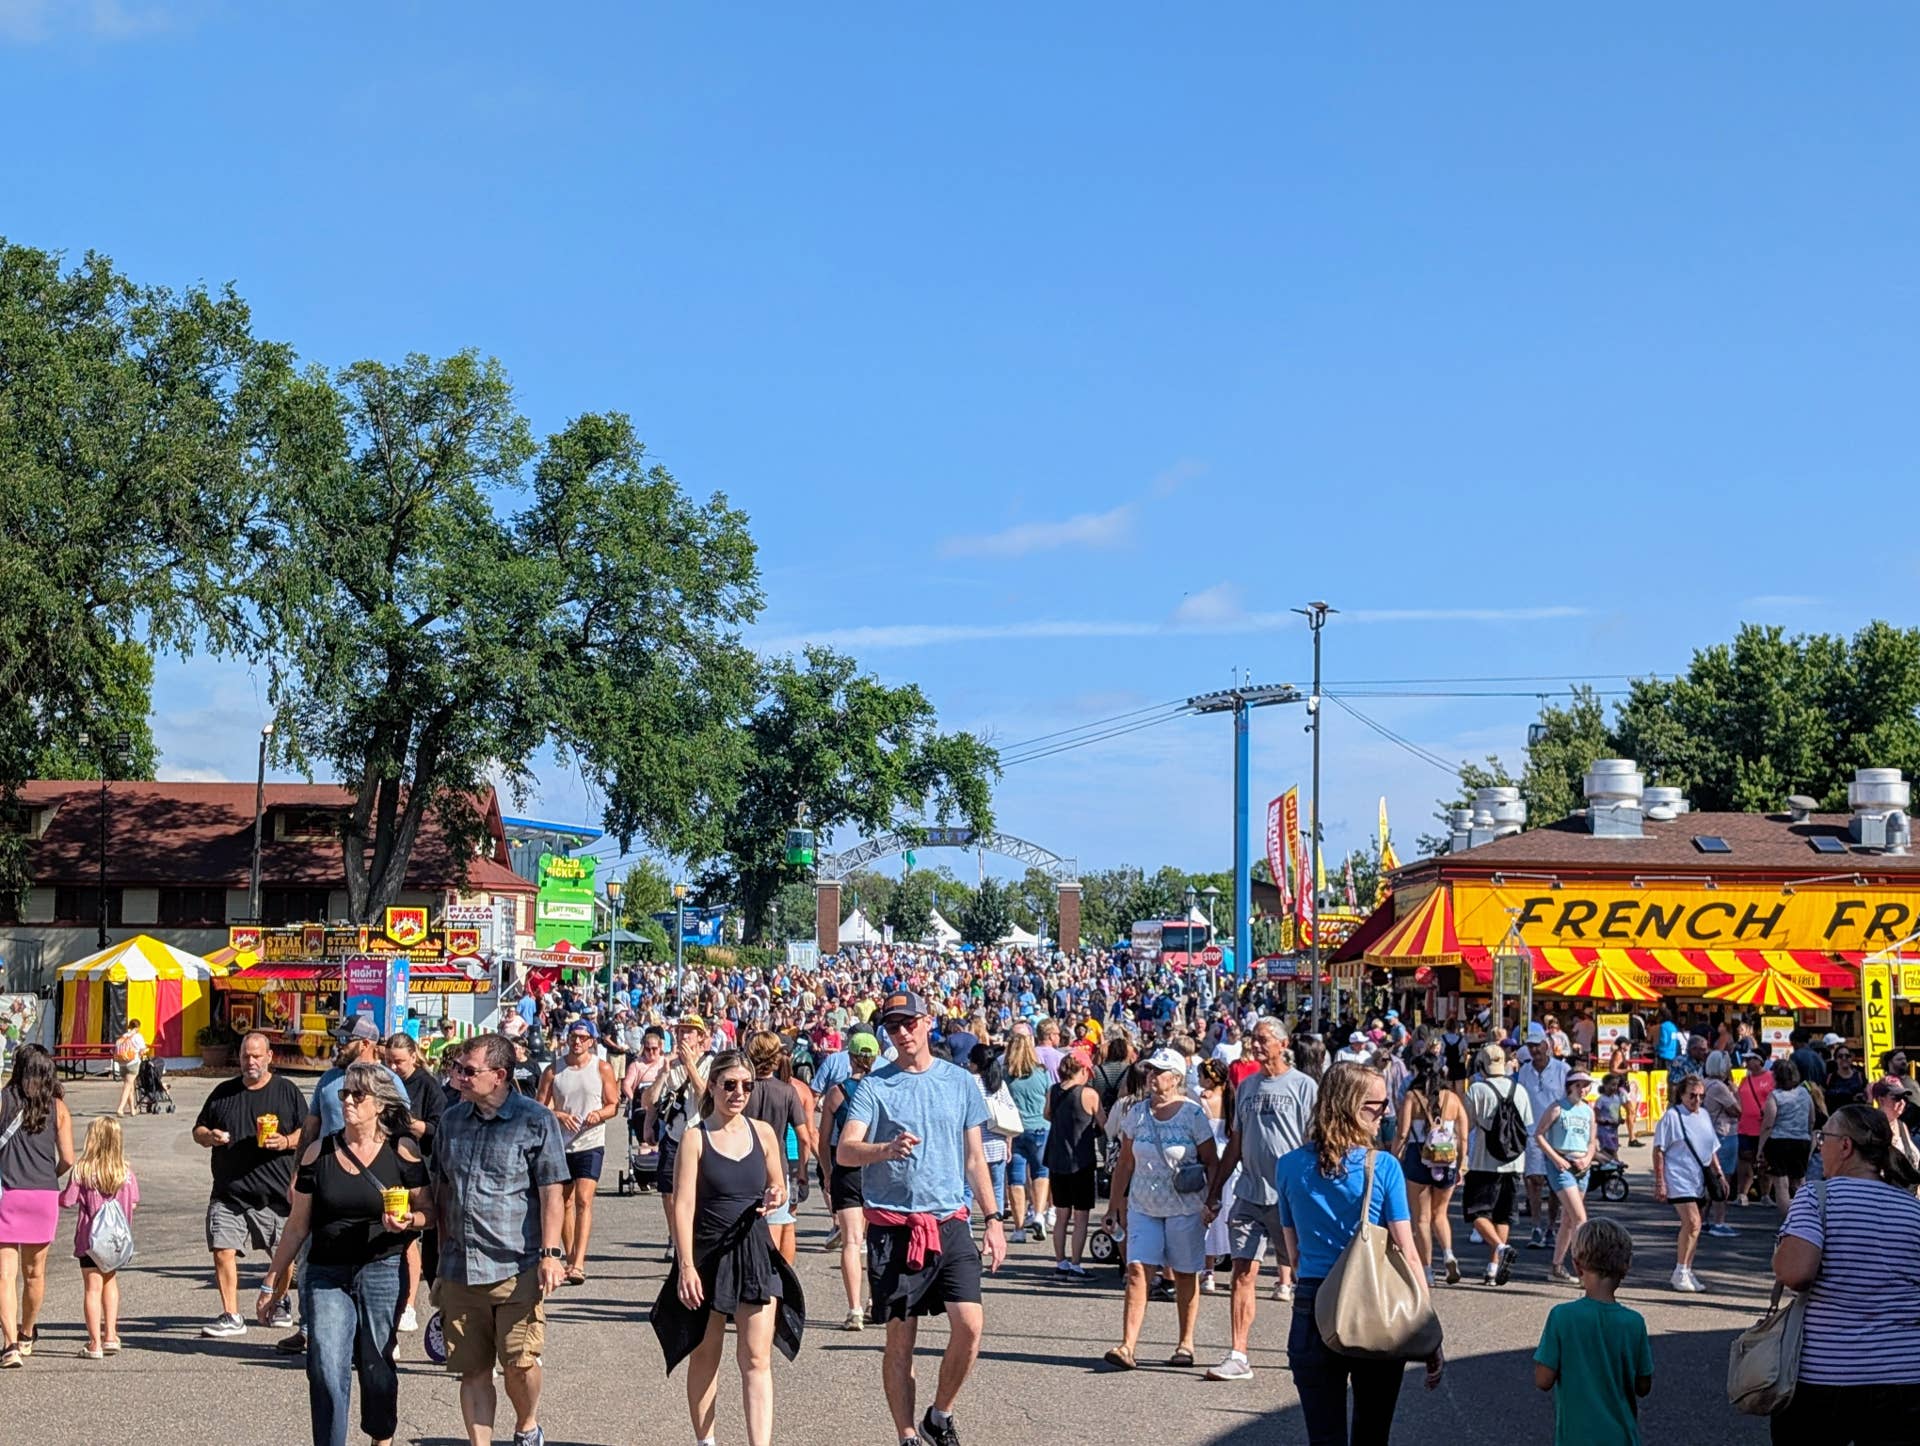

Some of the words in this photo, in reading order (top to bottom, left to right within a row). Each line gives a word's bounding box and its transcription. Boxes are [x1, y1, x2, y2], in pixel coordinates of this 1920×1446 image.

[1515, 897, 1786, 940] FRENCH
[266, 936, 302, 947] STEAK
[1203, 953, 1222, 962] STOP
[350, 969, 383, 977] MIGHTY
[423, 980, 472, 992] SANDWICHES
